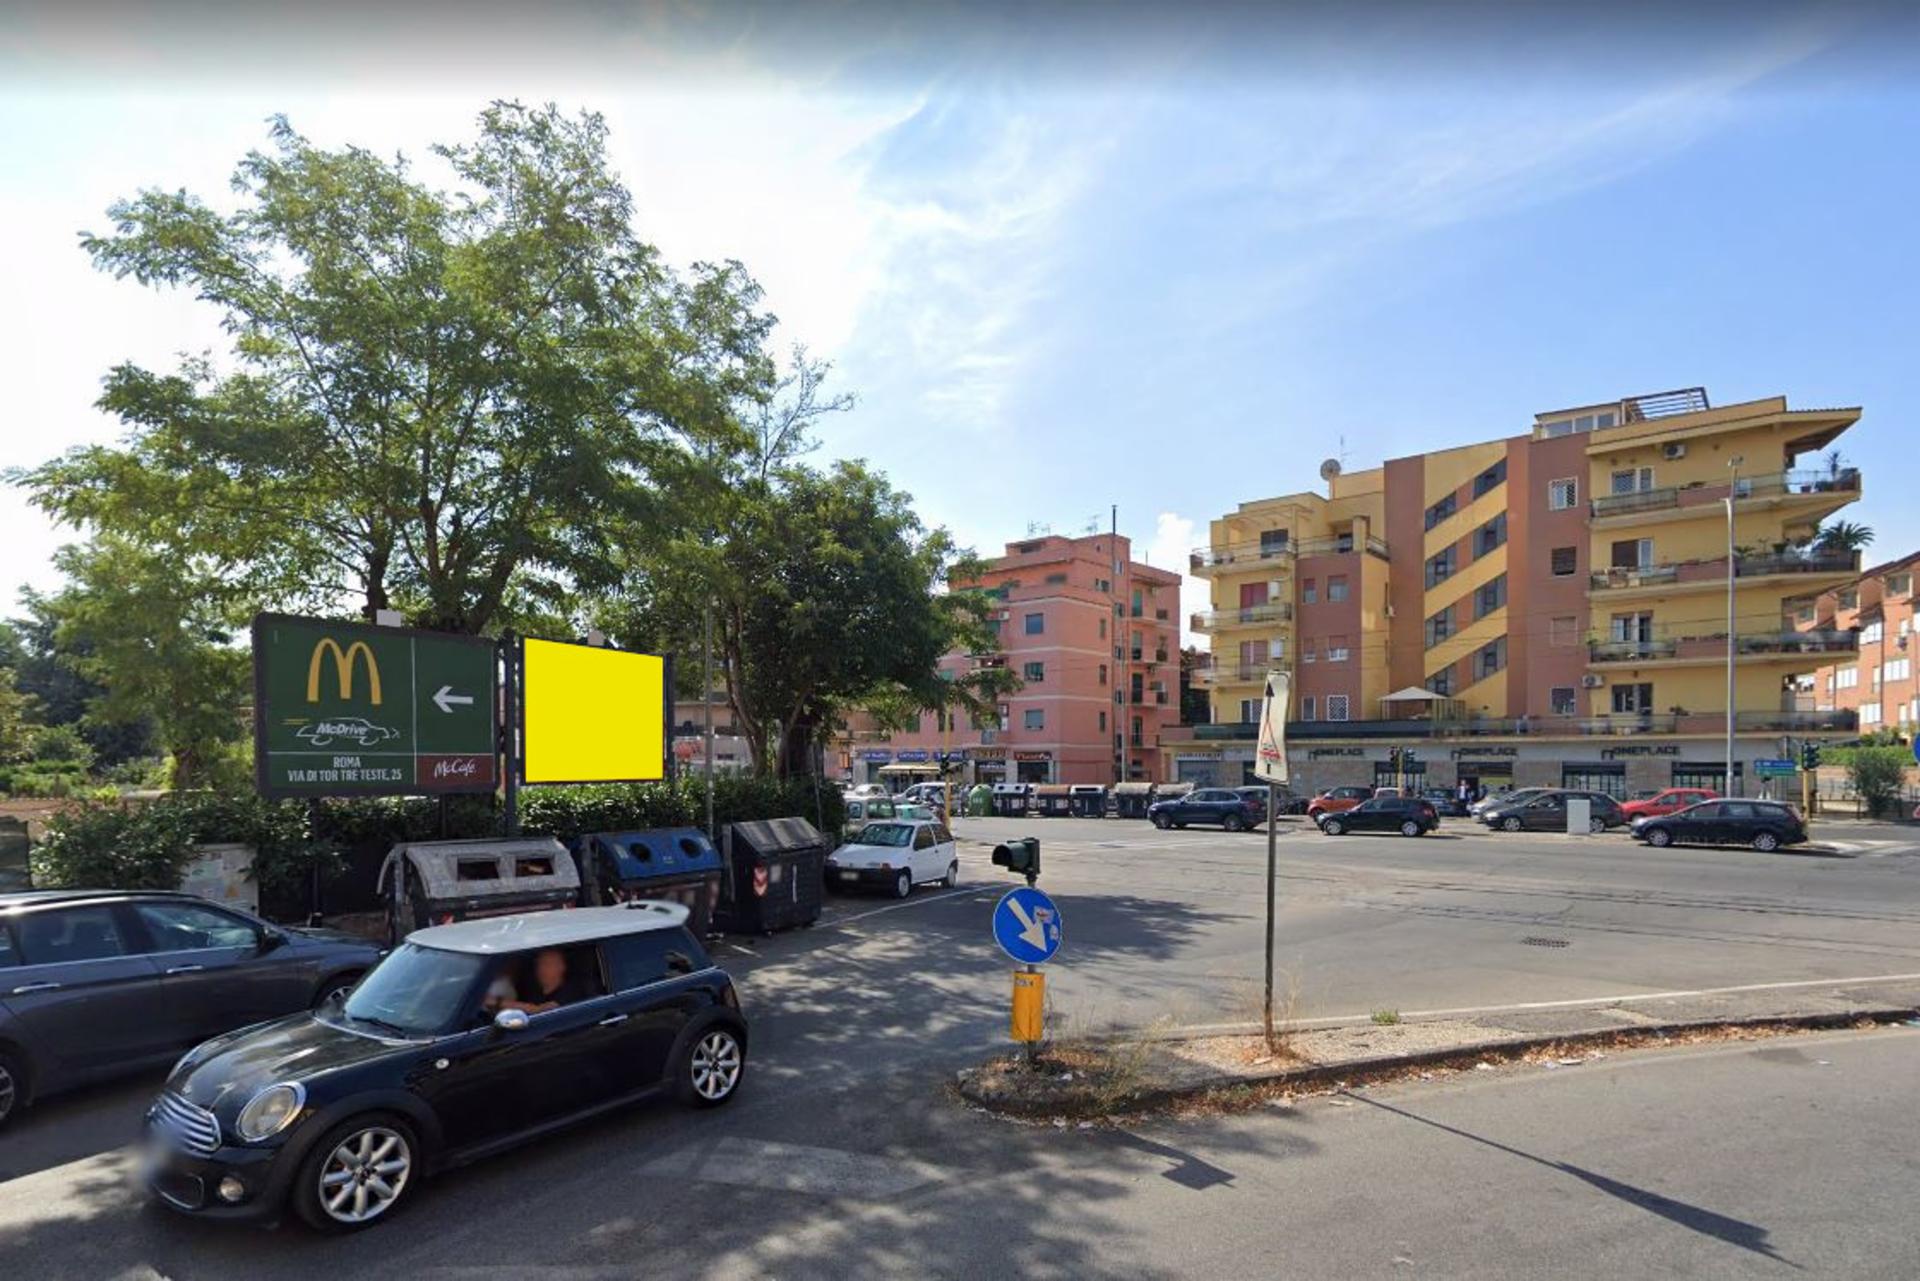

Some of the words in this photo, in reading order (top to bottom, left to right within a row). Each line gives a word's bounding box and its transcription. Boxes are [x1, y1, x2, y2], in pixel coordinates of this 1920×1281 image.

[316, 723, 368, 735] McDrive
[333, 756, 361, 768] ROMA
[288, 770, 305, 782] VIA
[306, 770, 317, 781] DI
[319, 770, 338, 781] TOR
[341, 769, 359, 781] TRE
[391, 769, 402, 780] 25
